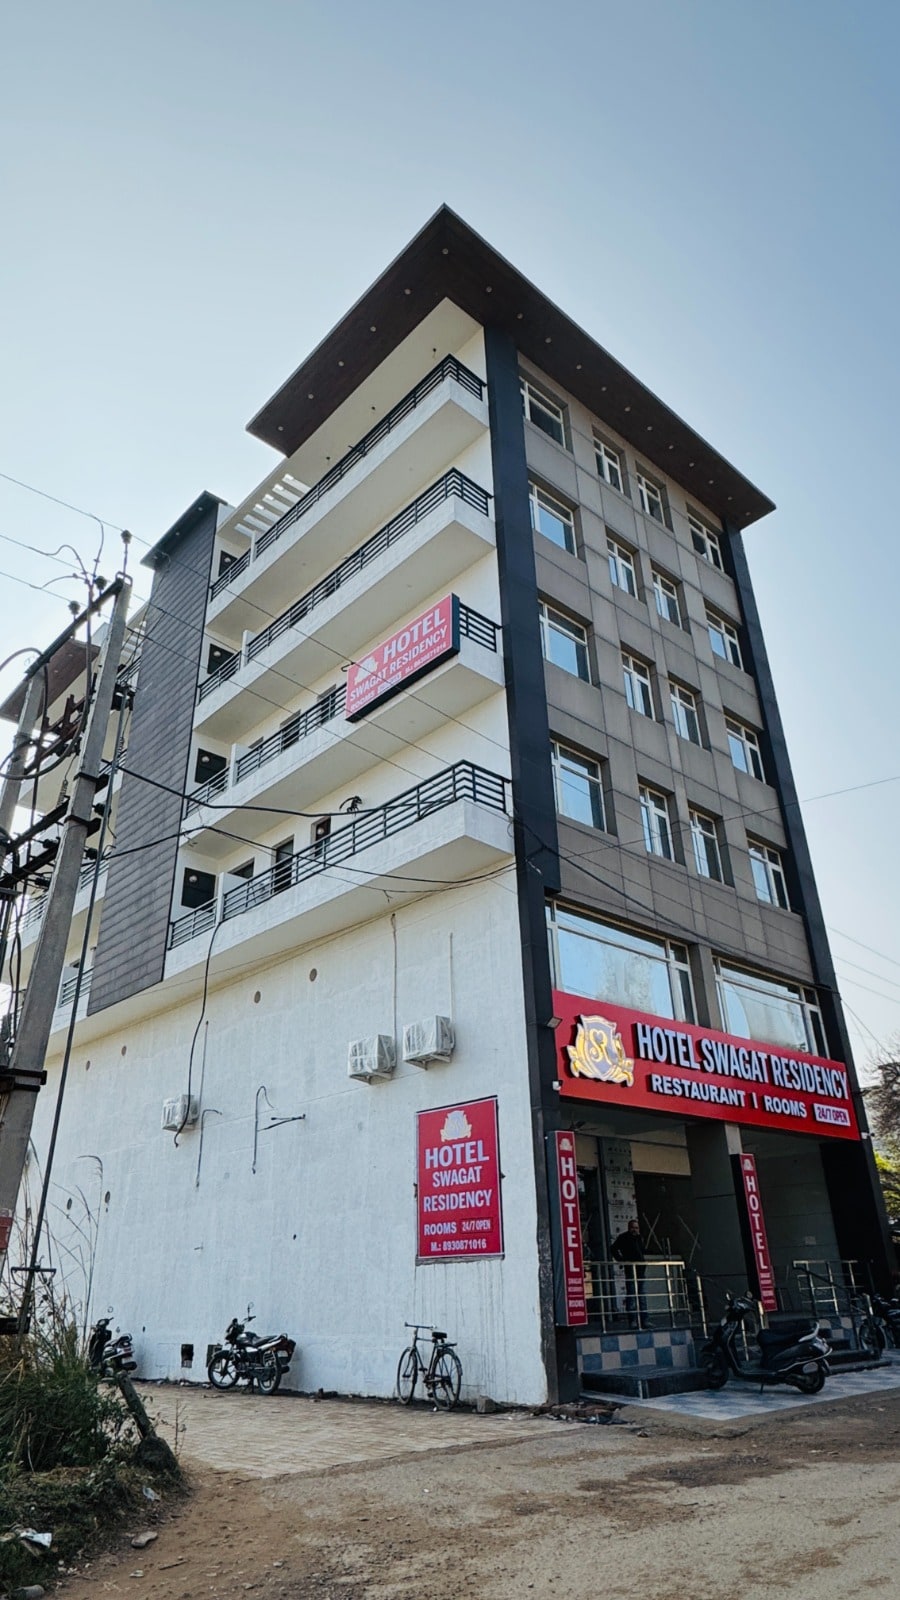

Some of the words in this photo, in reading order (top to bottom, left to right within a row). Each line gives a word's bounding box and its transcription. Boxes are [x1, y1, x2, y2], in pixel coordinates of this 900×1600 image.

[383, 608, 446, 664] HOTEL
[349, 668, 388, 702] SWAGAT
[389, 624, 448, 675] RESIDENCY
[636, 1022, 701, 1071] HOTEL
[700, 1038, 770, 1084] SWAGAT
[770, 1053, 850, 1101] RESIDENCY
[651, 1074, 746, 1108] RESTAURANT
[764, 1095, 807, 1119] ROOMS
[832, 1109, 849, 1124] OPEN
[425, 1140, 490, 1169] HOTEL
[432, 1166, 483, 1188] SWAGAT
[423, 1189, 493, 1213] RESIDENCY
[423, 1221, 457, 1236] ROOMS
[462, 1221, 476, 1232] 24/7
[475, 1219, 491, 1231] OPEN
[561, 1157, 580, 1272] HOTEL
[745, 1175, 768, 1270] HOTEL
